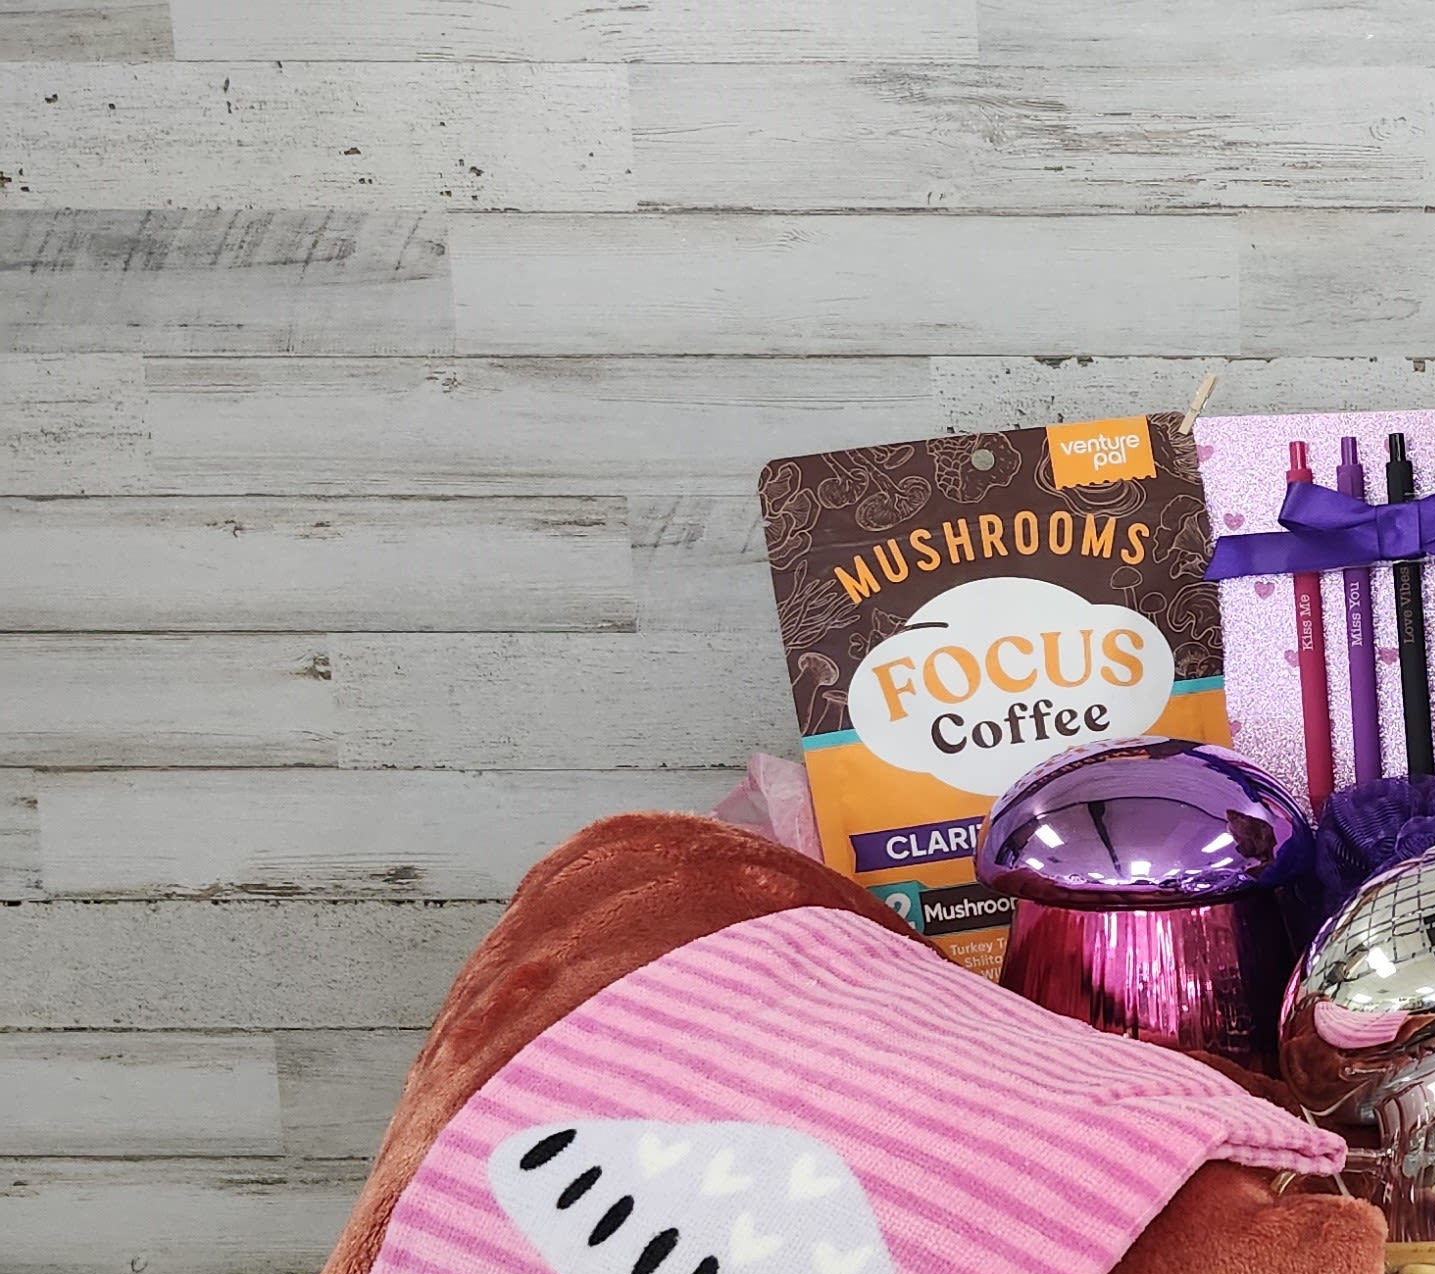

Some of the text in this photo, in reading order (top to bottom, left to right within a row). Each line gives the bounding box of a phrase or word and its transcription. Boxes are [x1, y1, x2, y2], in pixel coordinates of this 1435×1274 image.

[1060, 433, 1140, 456] venture
[1093, 448, 1128, 471] pal
[834, 510, 1150, 605] MUSHROOMS
[1301, 593, 1314, 651] Kiss Me
[1349, 581, 1364, 647] Miss You
[1400, 567, 1416, 644] Love Vibes
[872, 628, 1145, 722] FOCUS
[931, 699, 1110, 754] Coffee
[950, 941, 993, 956] Turkey
